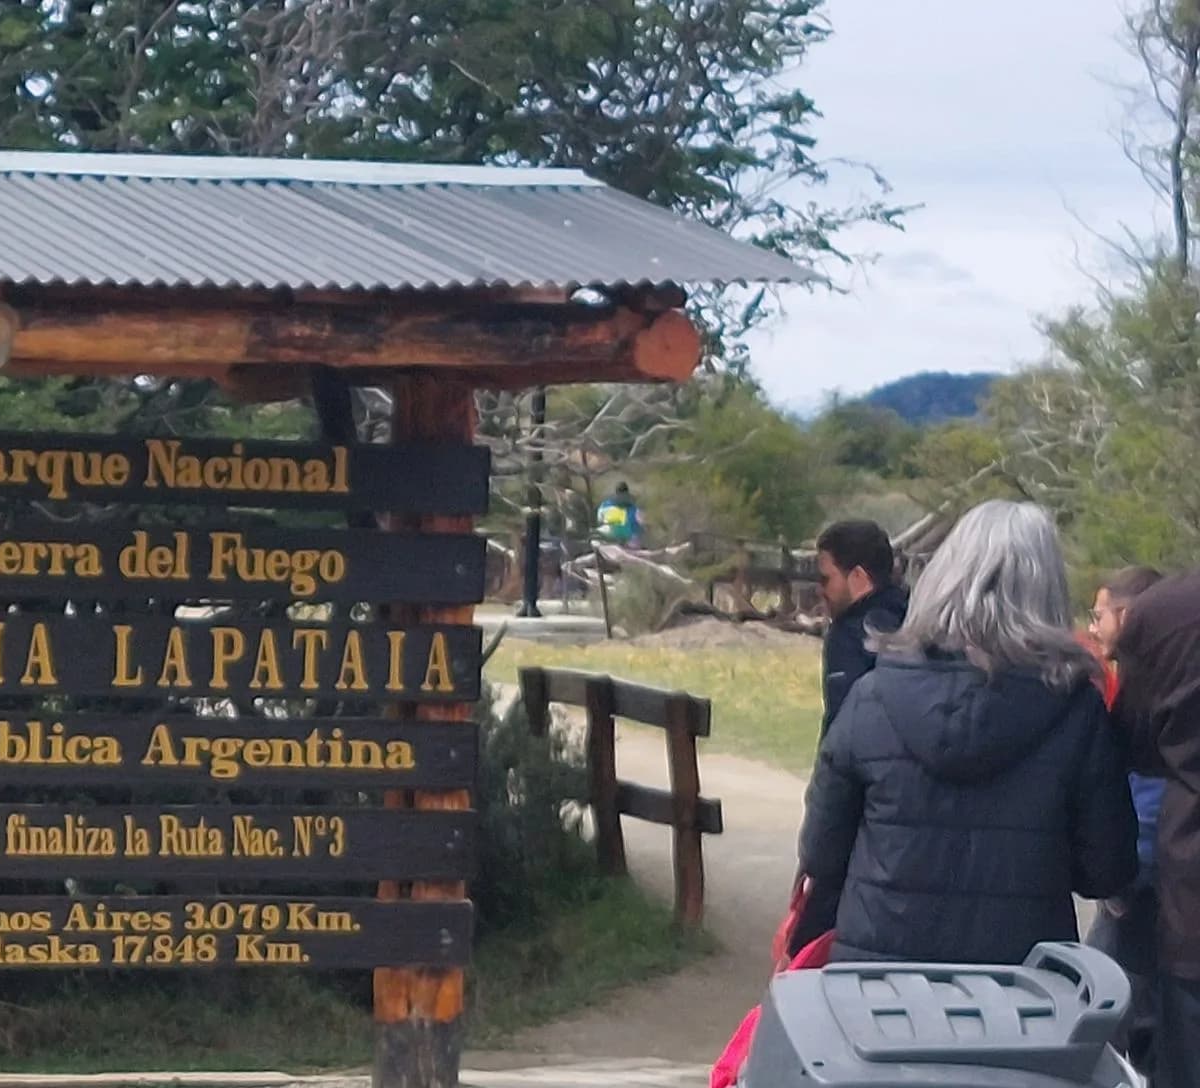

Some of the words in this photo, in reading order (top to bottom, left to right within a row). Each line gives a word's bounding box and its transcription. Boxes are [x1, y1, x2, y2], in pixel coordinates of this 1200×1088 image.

[145, 439, 351, 493] Nacional
[118, 532, 190, 580] del
[208, 532, 346, 596] Fuego
[111, 624, 456, 693] LAPATAIA
[141, 725, 416, 780] Argentina
[5, 813, 118, 858] finaliza
[124, 815, 151, 857] la
[159, 814, 225, 858] Ruta
[232, 815, 285, 858] Nac.
[63, 902, 174, 933] Aires
[184, 901, 282, 932] 3.079
[285, 902, 362, 932] Km.
[112, 933, 219, 965] 17.848
[234, 933, 312, 964] Km.
